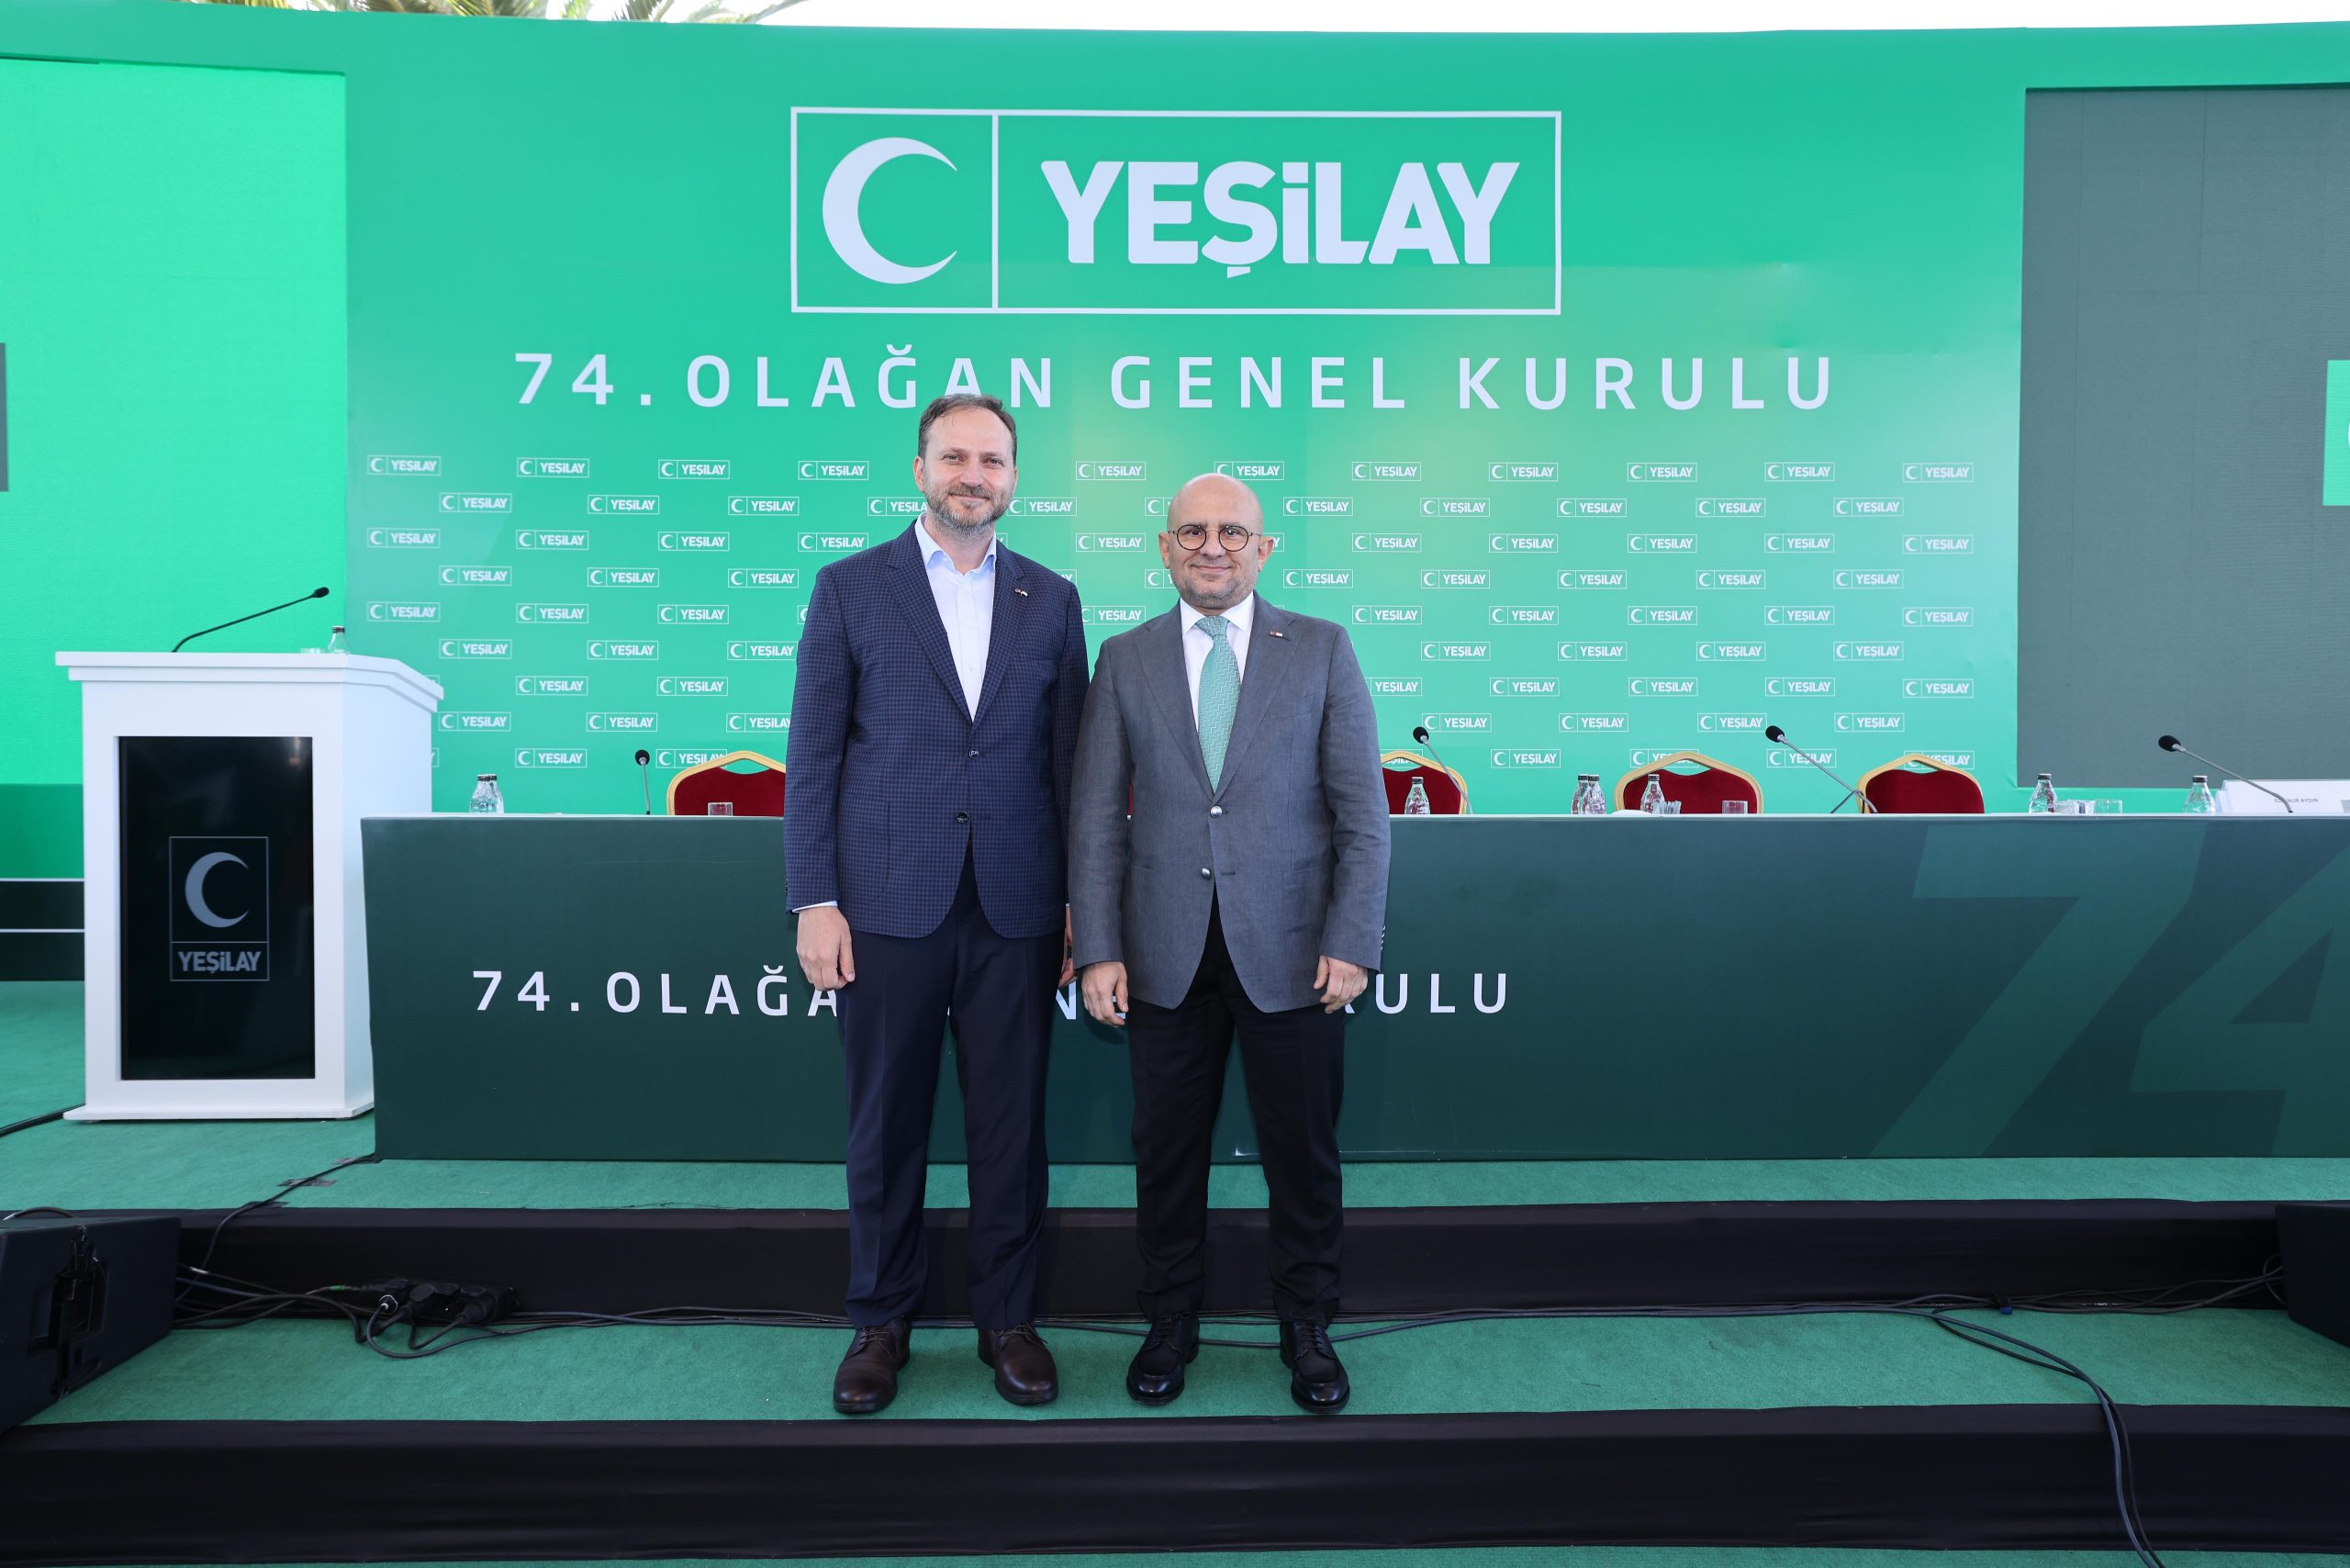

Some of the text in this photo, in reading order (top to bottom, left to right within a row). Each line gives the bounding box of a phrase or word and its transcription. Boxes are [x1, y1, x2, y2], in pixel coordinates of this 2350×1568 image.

[515, 343, 1830, 411] 74. OLAĞAN GENEL KURULU
[473, 970, 579, 1012] 74.
[606, 962, 837, 1017] OLAĞA
